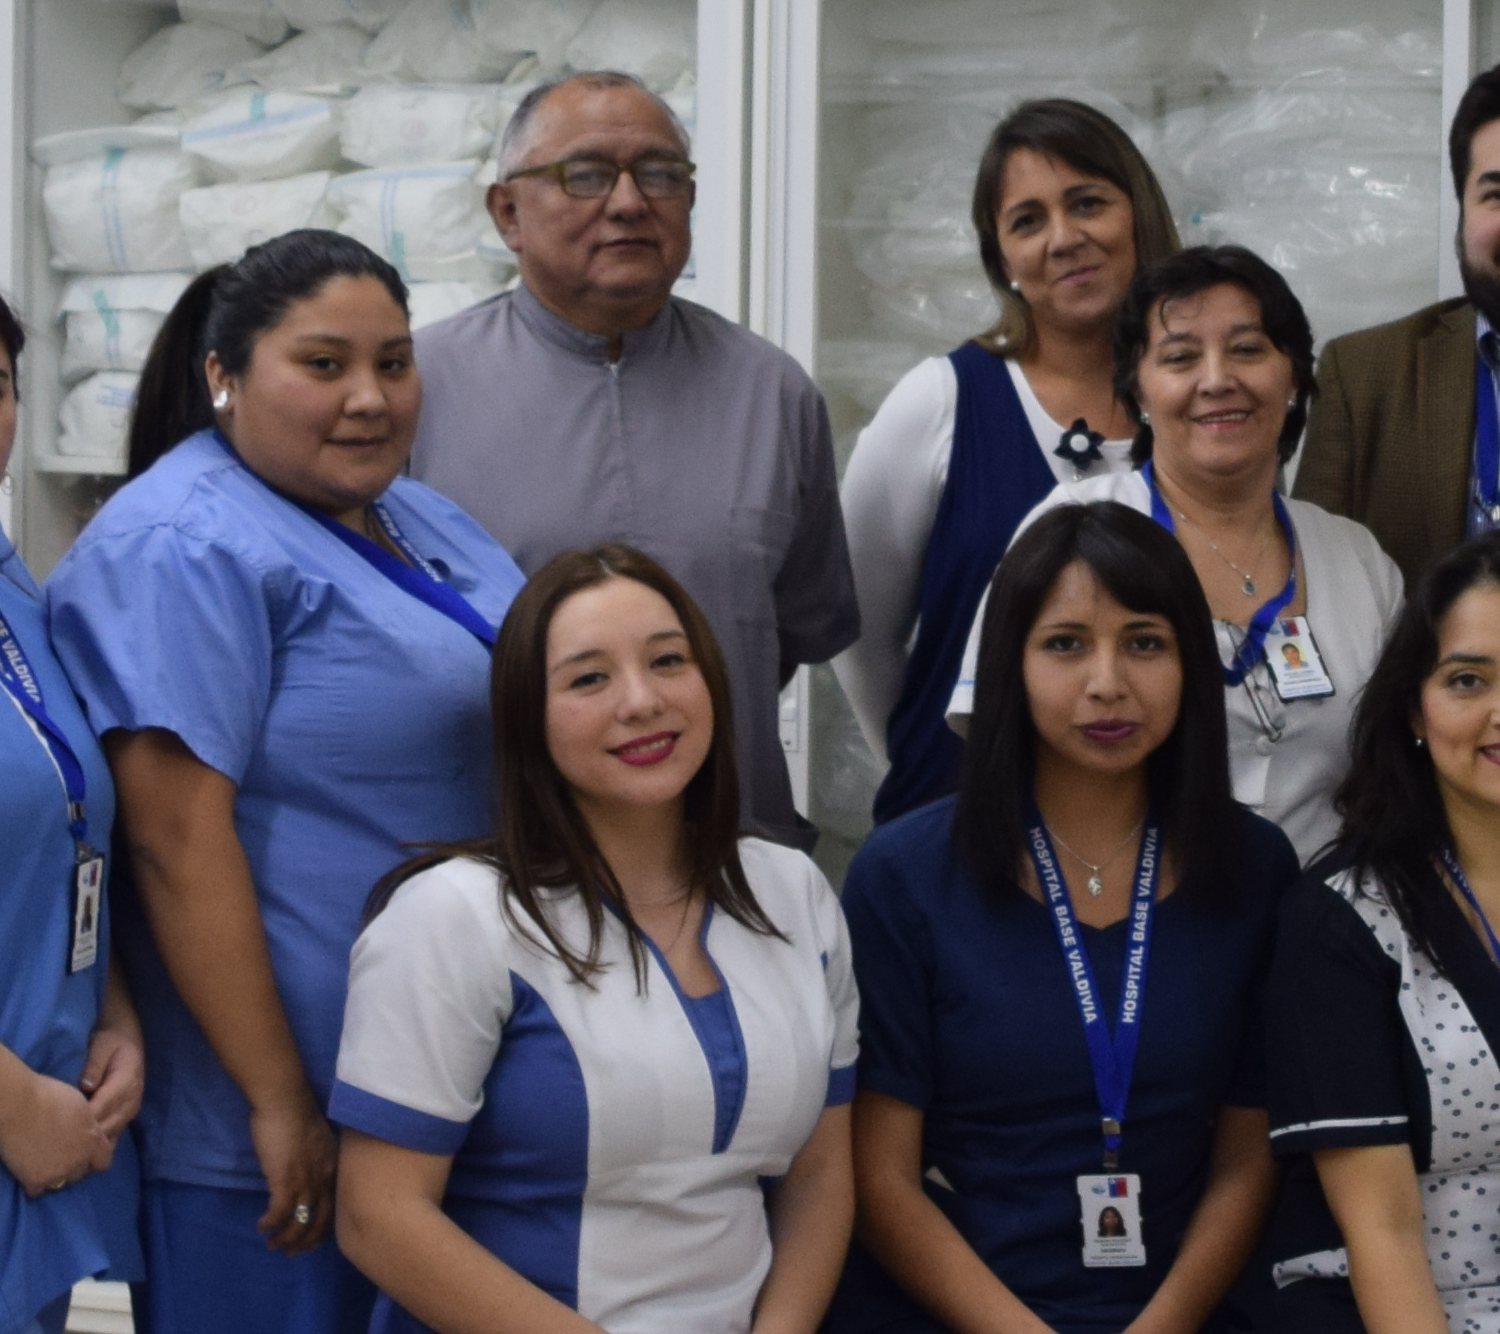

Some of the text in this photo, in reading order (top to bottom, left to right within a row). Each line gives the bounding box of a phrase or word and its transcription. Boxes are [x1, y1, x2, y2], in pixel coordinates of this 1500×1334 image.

[1029, 825, 1099, 1025] HOSPITAL BASE VALDIVIA
[1121, 826, 1159, 1024] HOSPITAL BASE VALDIVIA
